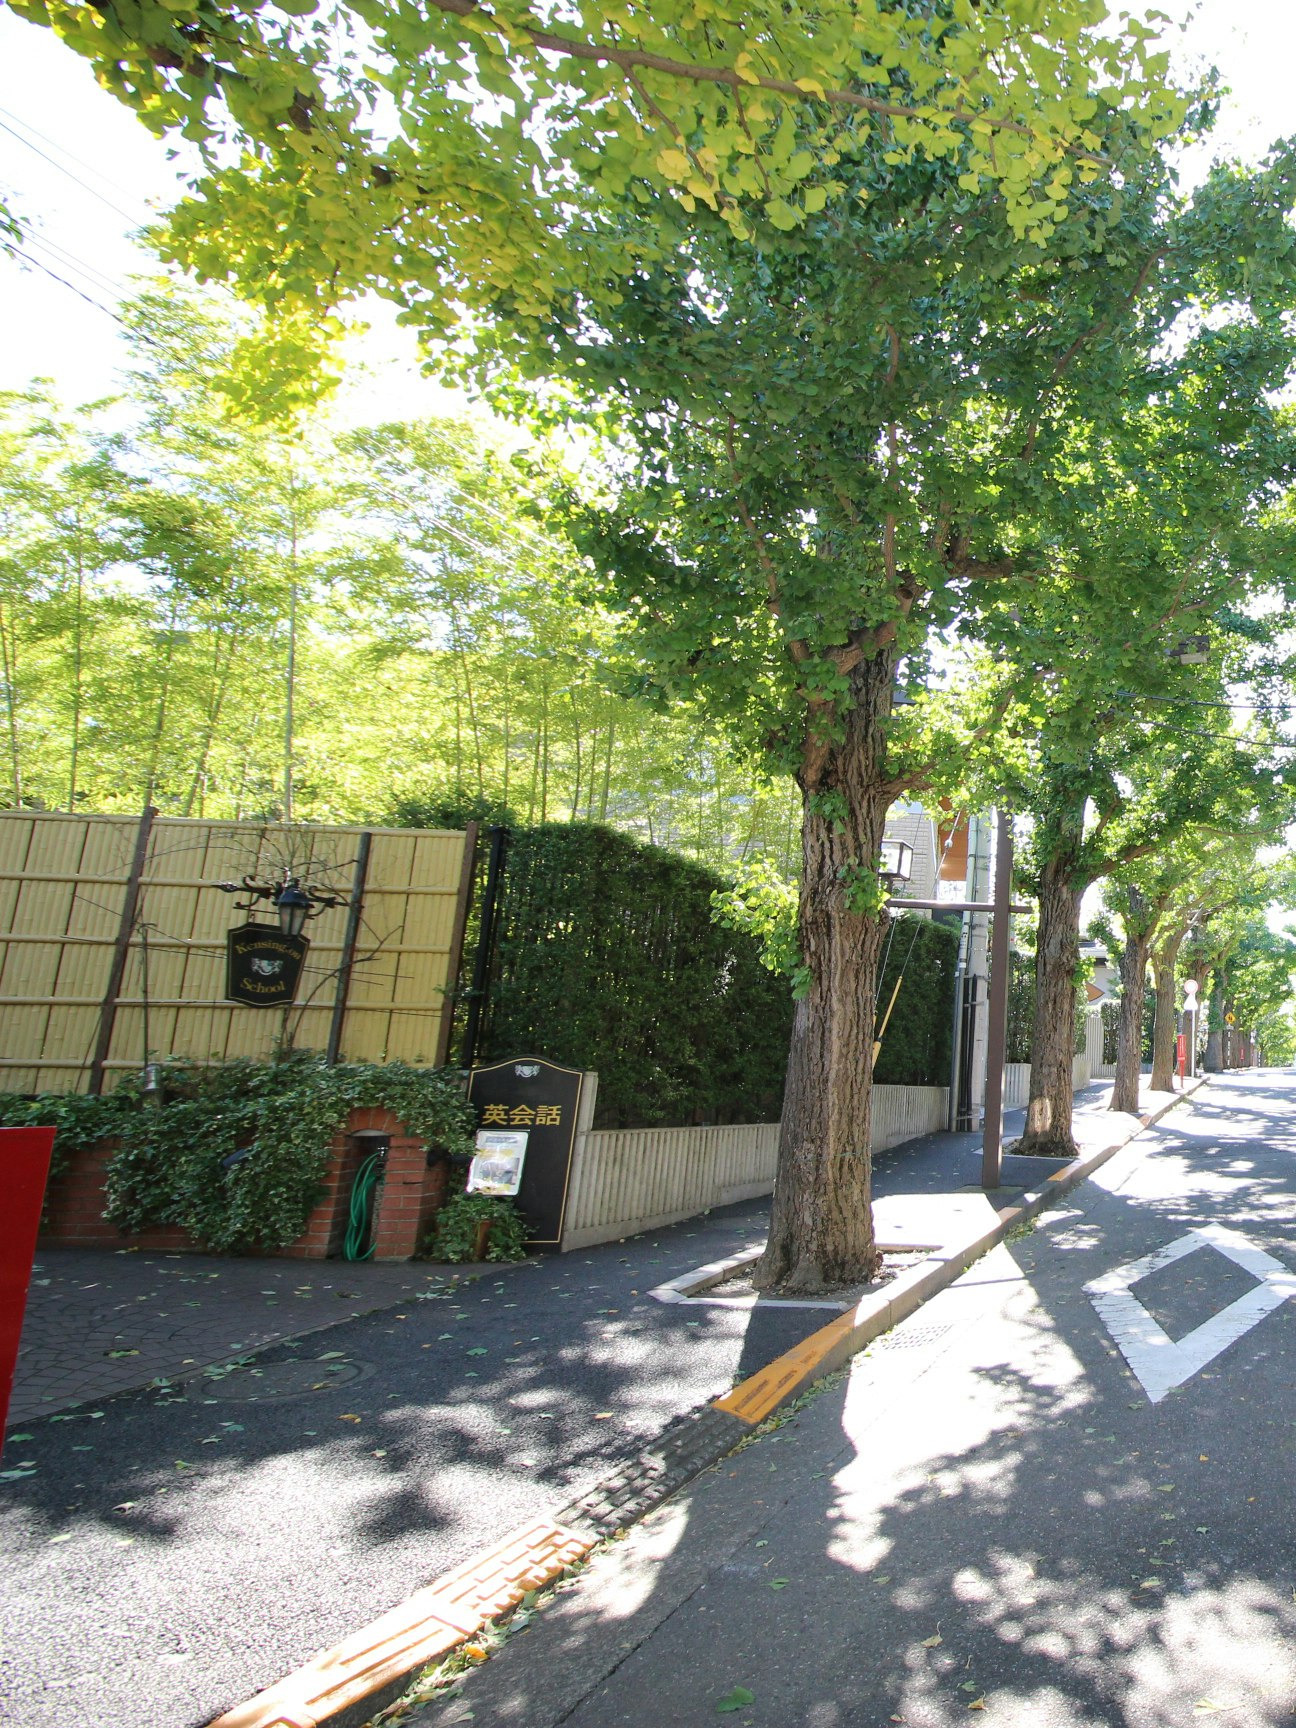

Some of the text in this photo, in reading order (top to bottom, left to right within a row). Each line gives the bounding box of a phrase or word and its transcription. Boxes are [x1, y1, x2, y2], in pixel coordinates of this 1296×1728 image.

[240, 977, 286, 993] School
[482, 1103, 562, 1126] 英会話
